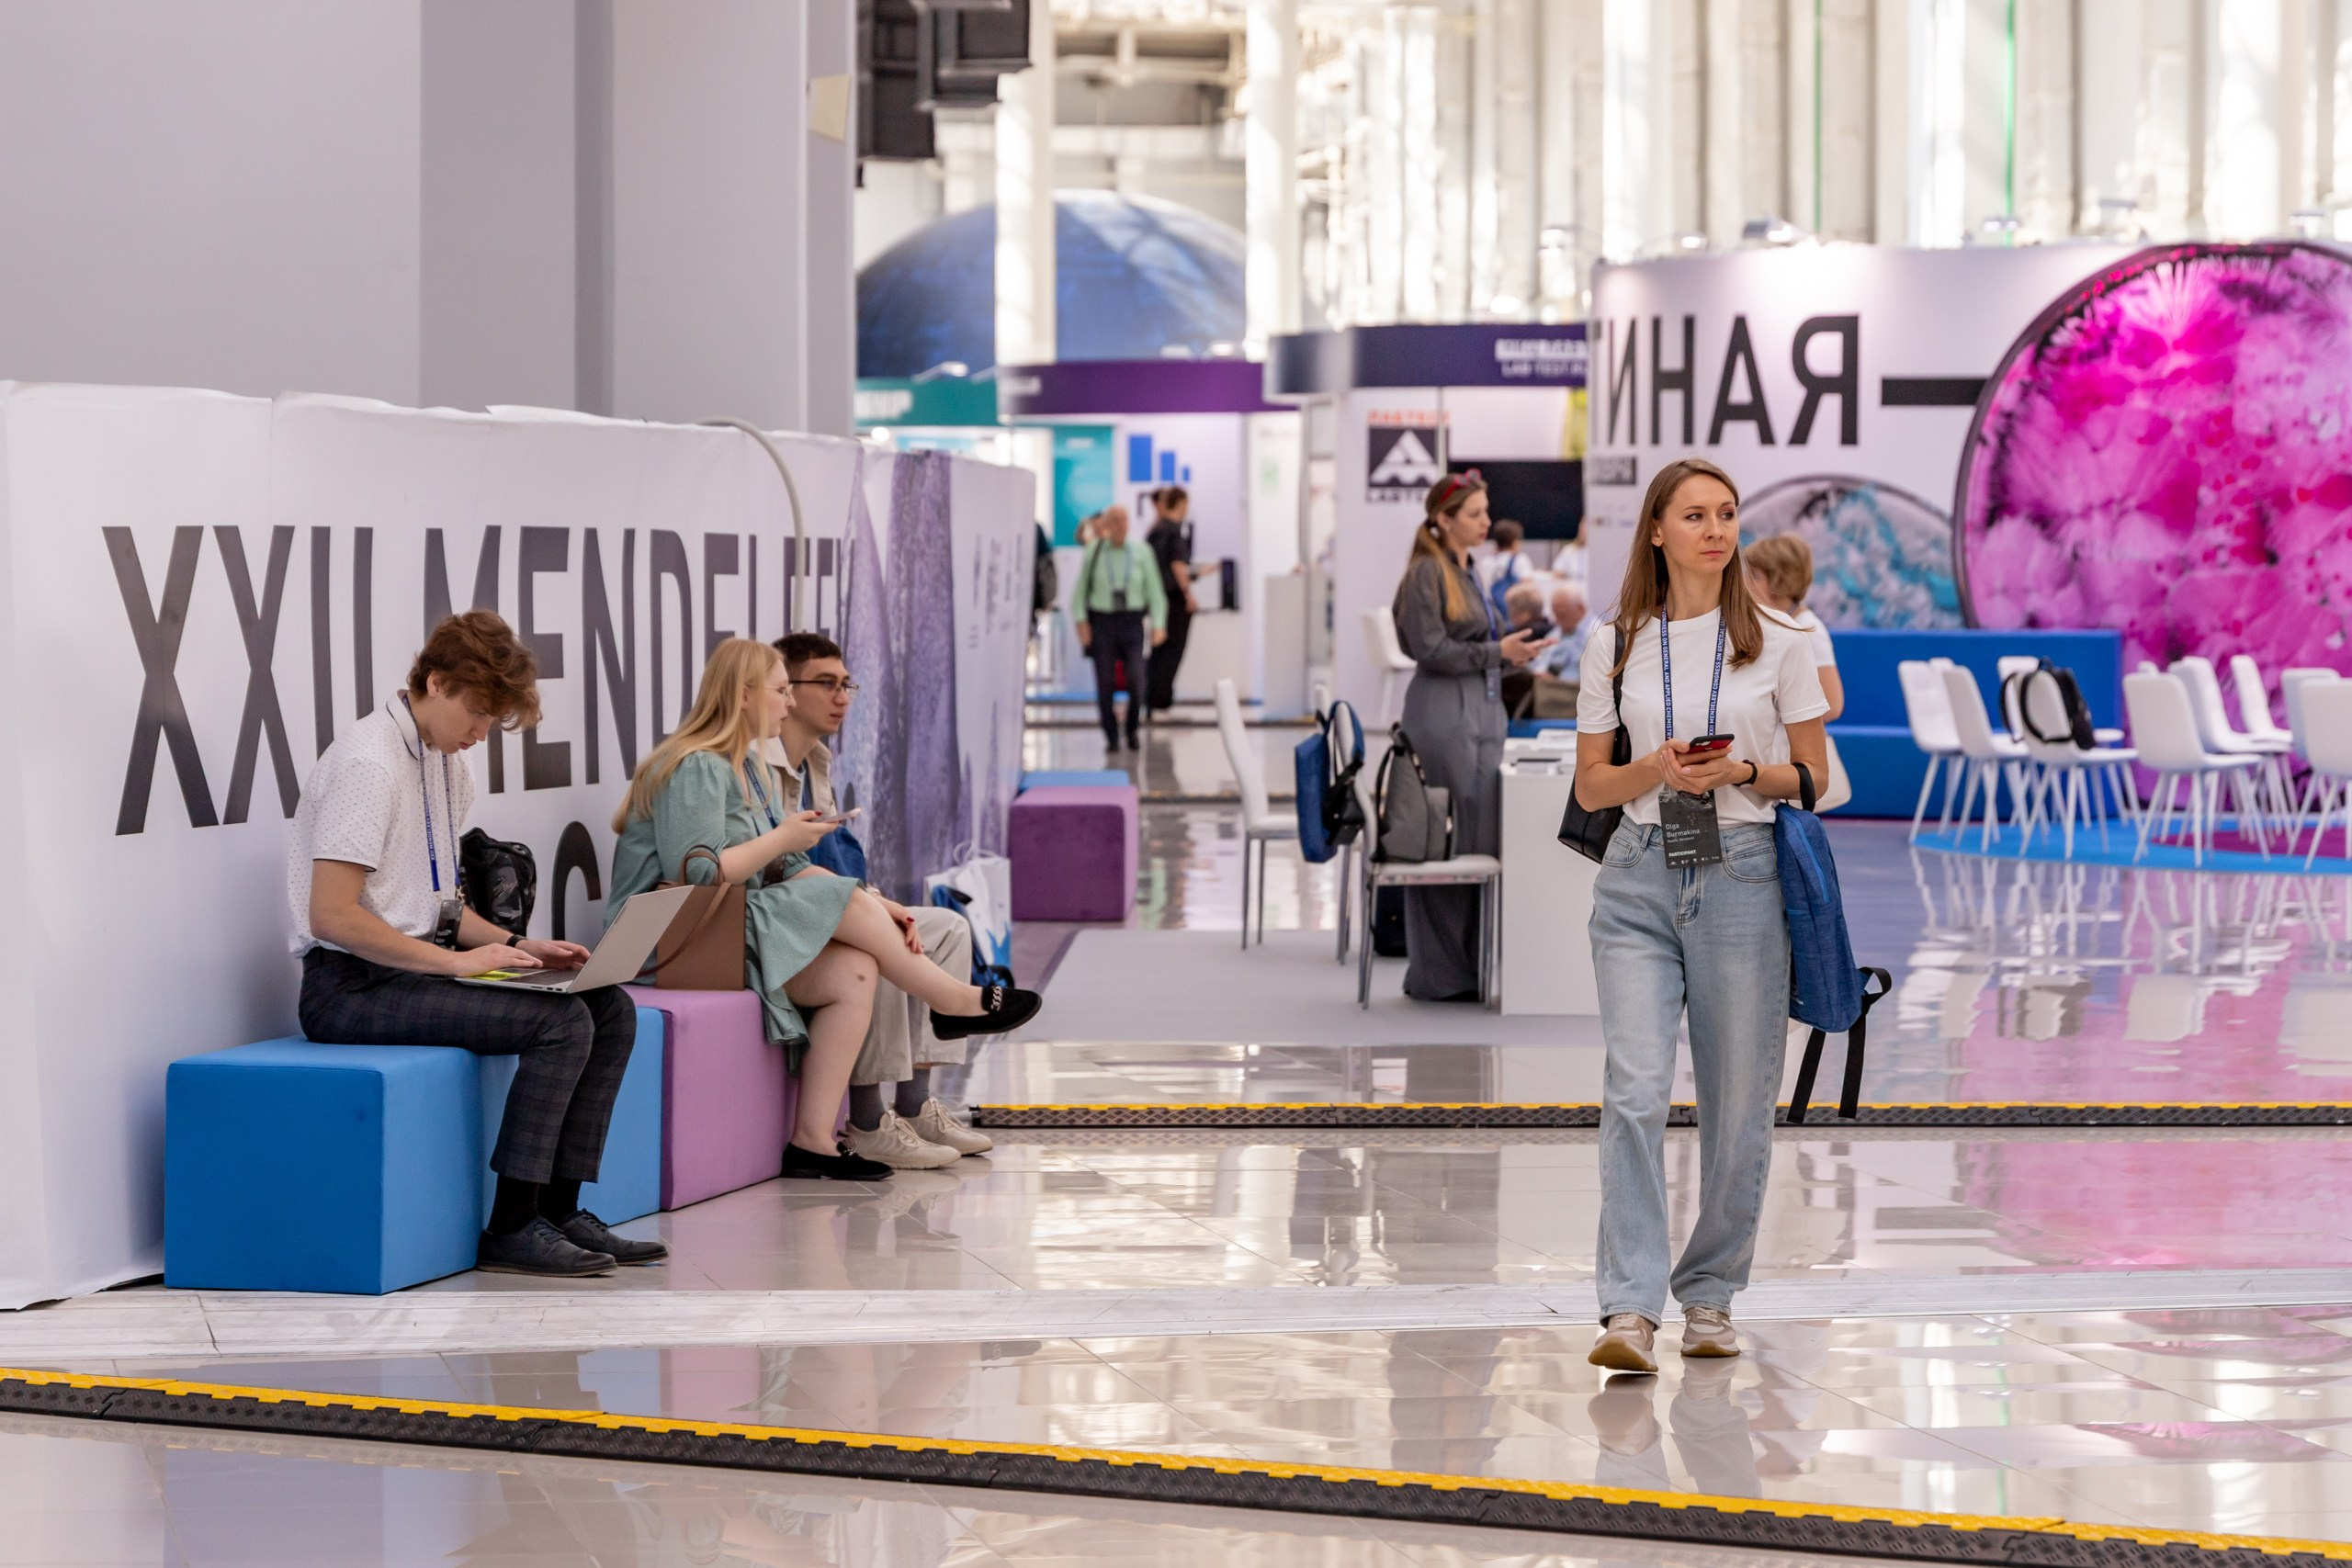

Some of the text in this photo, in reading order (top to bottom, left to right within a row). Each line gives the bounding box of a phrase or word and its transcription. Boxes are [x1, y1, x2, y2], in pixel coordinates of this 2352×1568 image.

[1591, 315, 1860, 446] ИНАЯ
[101, 525, 373, 835] XXII
[1709, 691, 1717, 724] MENDELEEV
[1713, 661, 1722, 690] CONGRESS
